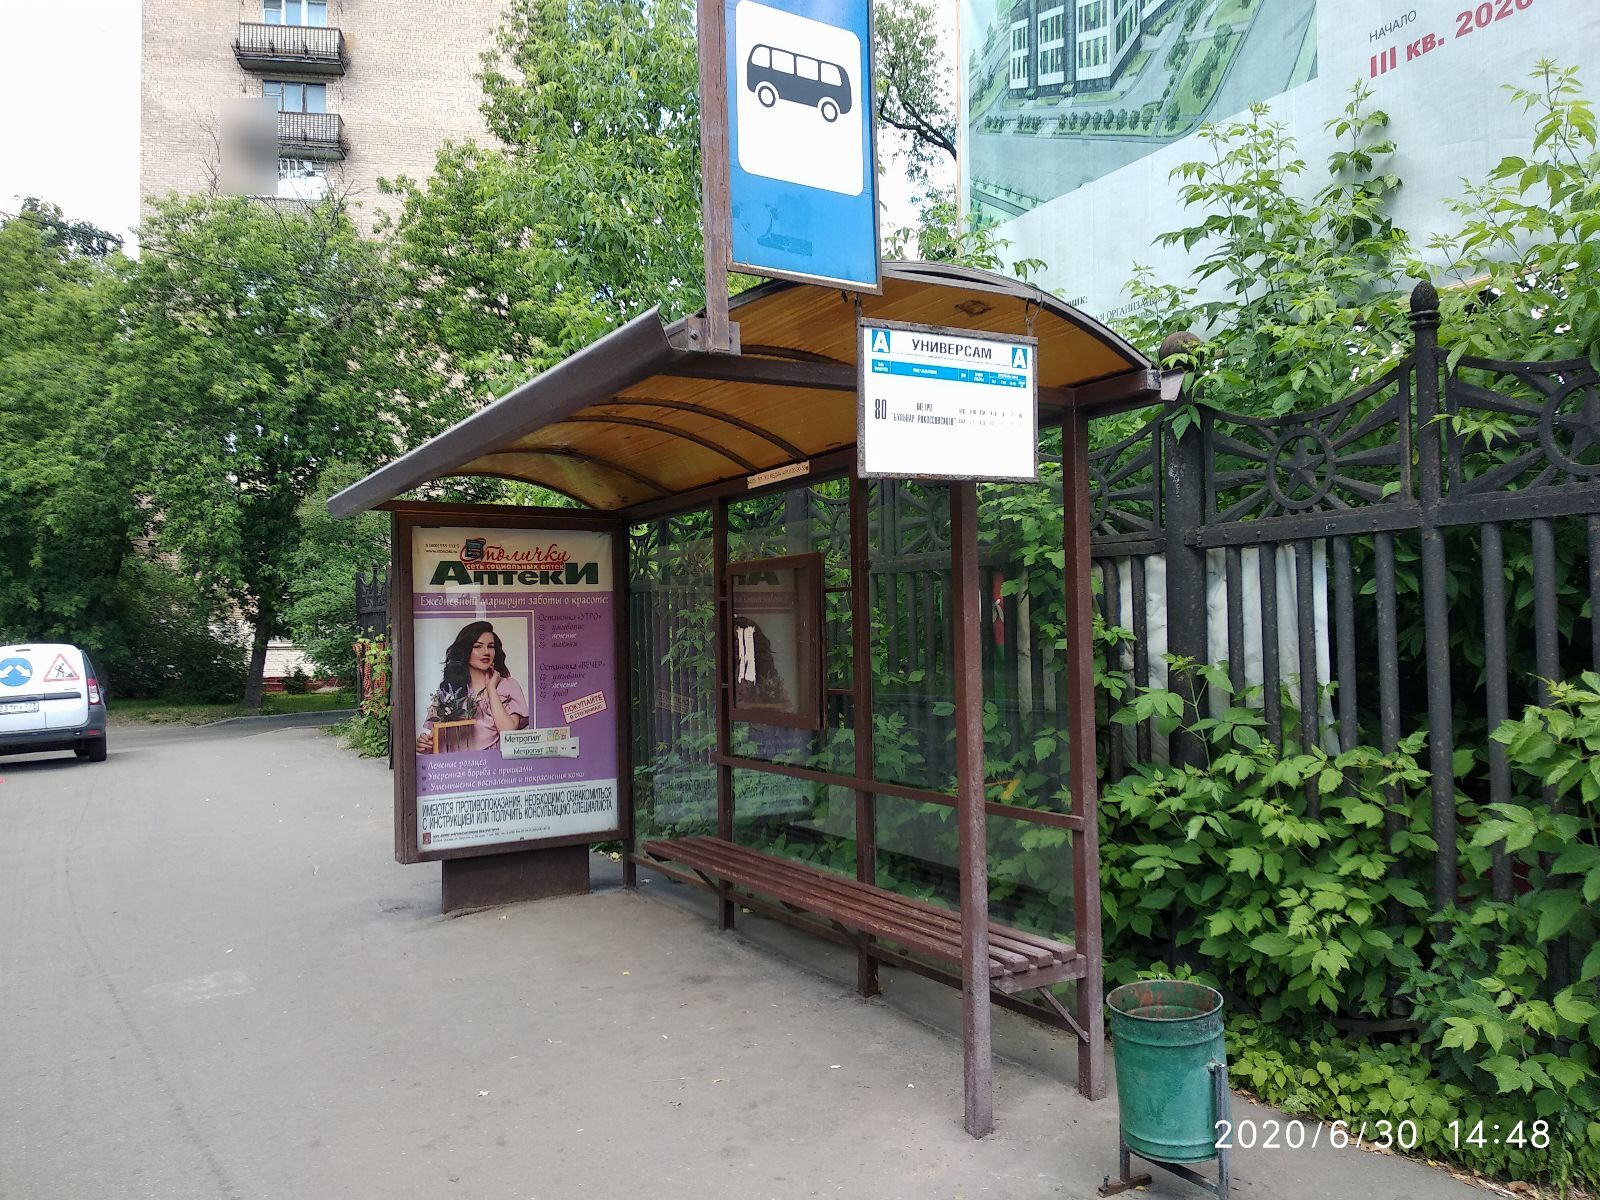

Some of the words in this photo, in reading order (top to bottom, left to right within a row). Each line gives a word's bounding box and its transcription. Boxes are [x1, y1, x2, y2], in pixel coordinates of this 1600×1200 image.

[1369, 10, 1417, 43] НАЧАЛО
[1370, 46, 1397, 79] III
[1406, 33, 1445, 62] кв.
[912, 338, 992, 360] УНИВЕРСАМ
[874, 398, 887, 420] 80
[466, 563, 485, 571] сеть
[486, 563, 539, 571] социальных
[540, 563, 565, 571] аптек
[420, 594, 480, 607] Ежедневный
[481, 597, 526, 608] маршрут
[528, 594, 562, 605] заботы
[551, 681, 578, 689] лечение
[563, 693, 604, 714] ПОКУПАЙТЕ
[427, 761, 457, 770] Лечение
[427, 771, 466, 782] Уверенная
[467, 767, 491, 778] борьба
[499, 765, 533, 777] прыщами
[422, 801, 454, 818] ИМЕЮТСЯ
[524, 790, 565, 807] НЕОБХОДИМО
[566, 786, 612, 803] ОЗНАКОМИТЬСЯ
[422, 817, 428, 831] С
[429, 812, 475, 830] ИНСТРУКЦИЕЙ
[476, 811, 490, 825] ИЛИ
[491, 807, 523, 823] ПОЛУЧИТЬ
[524, 802, 571, 819] КОНСУЛЬТАЦИЮ
[572, 799, 613, 815] СПЕЦИАЛИСТА
